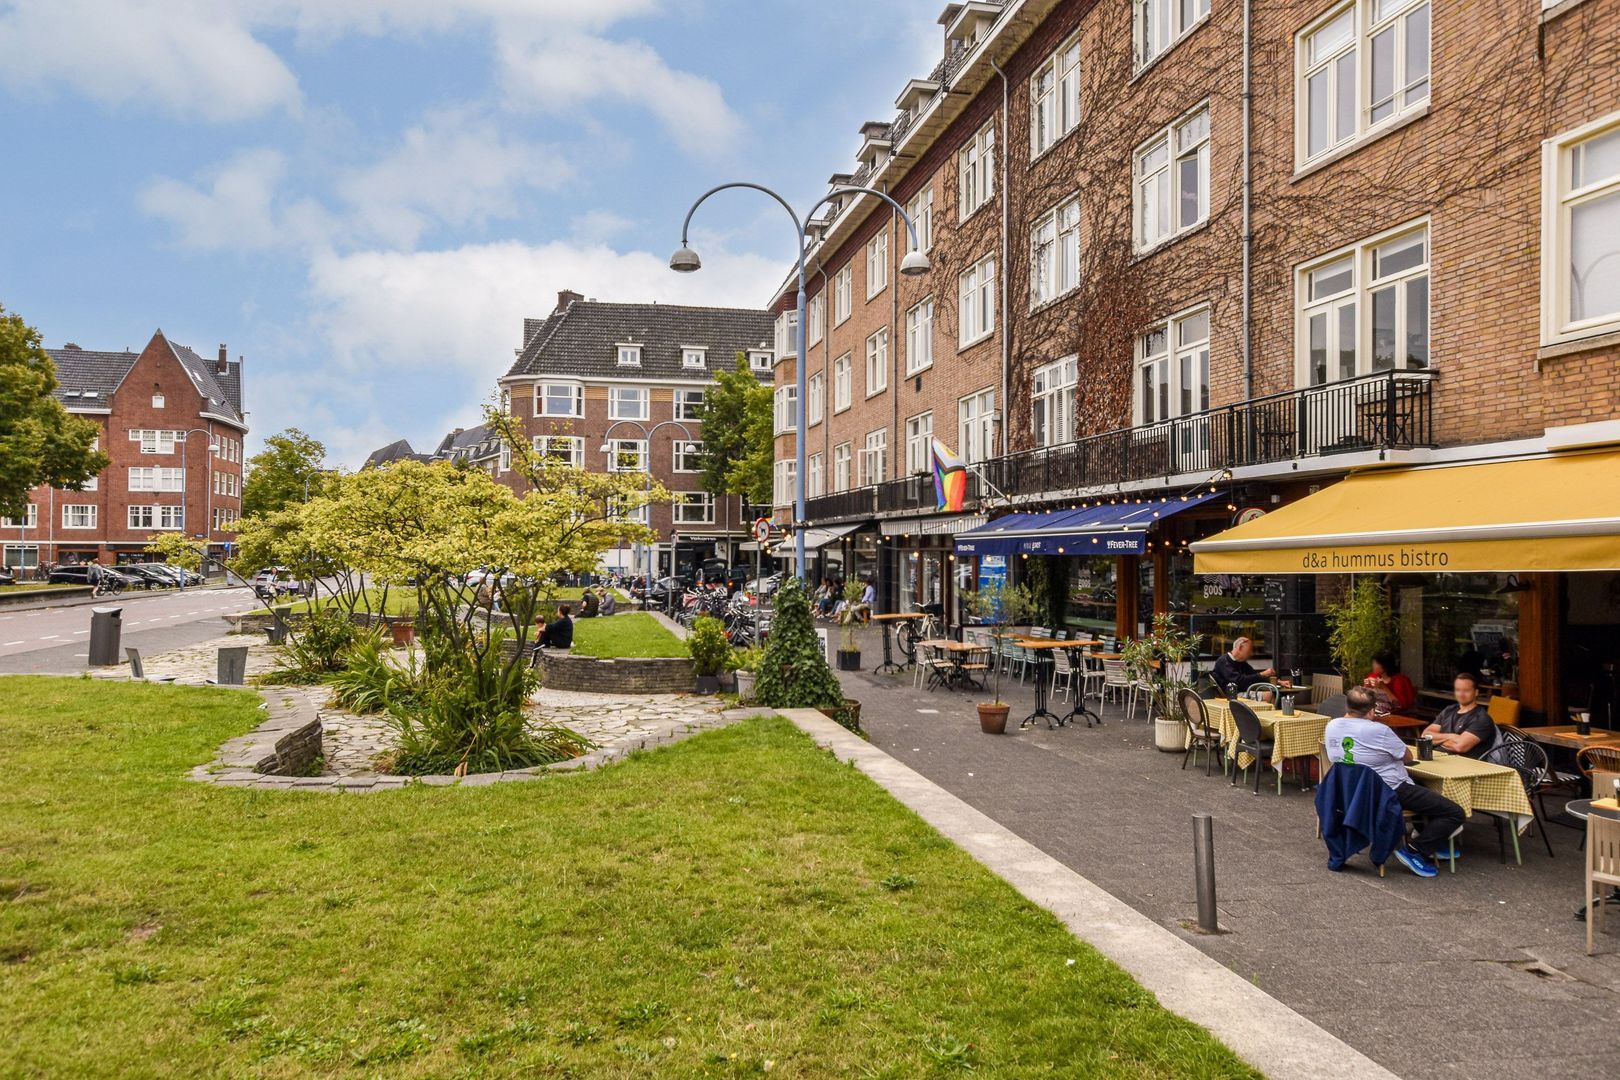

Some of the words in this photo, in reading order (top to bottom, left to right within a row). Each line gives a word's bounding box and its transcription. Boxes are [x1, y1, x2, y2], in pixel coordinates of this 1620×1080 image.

[1302, 552, 1327, 568] d&a
[1332, 551, 1395, 568] hummus
[1400, 549, 1449, 567] bistro
[1203, 584, 1223, 599] goos
